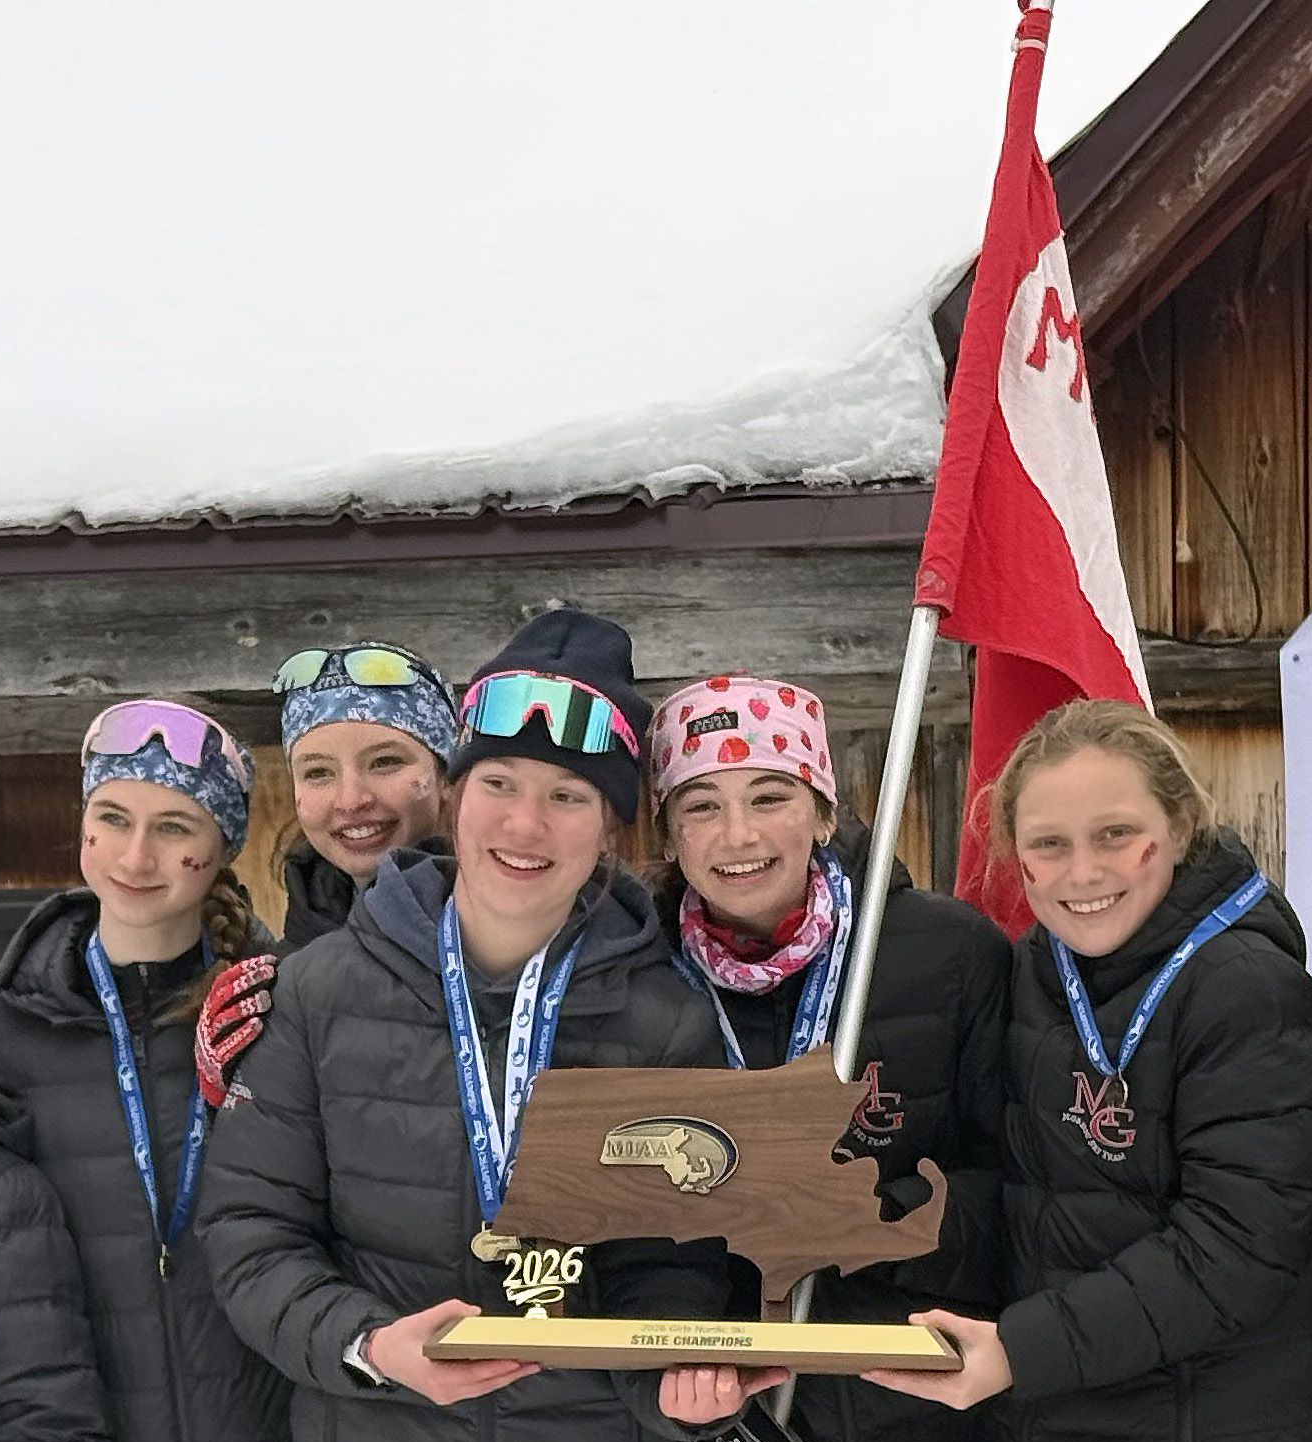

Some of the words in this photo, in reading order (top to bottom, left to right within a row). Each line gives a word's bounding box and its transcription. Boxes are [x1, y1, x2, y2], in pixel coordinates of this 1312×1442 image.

[606, 1139, 673, 1158] MIAA
[503, 1246, 587, 1287] 2026
[630, 1335, 669, 1346] STATE
[673, 1336, 753, 1347] CHAMPIONS
